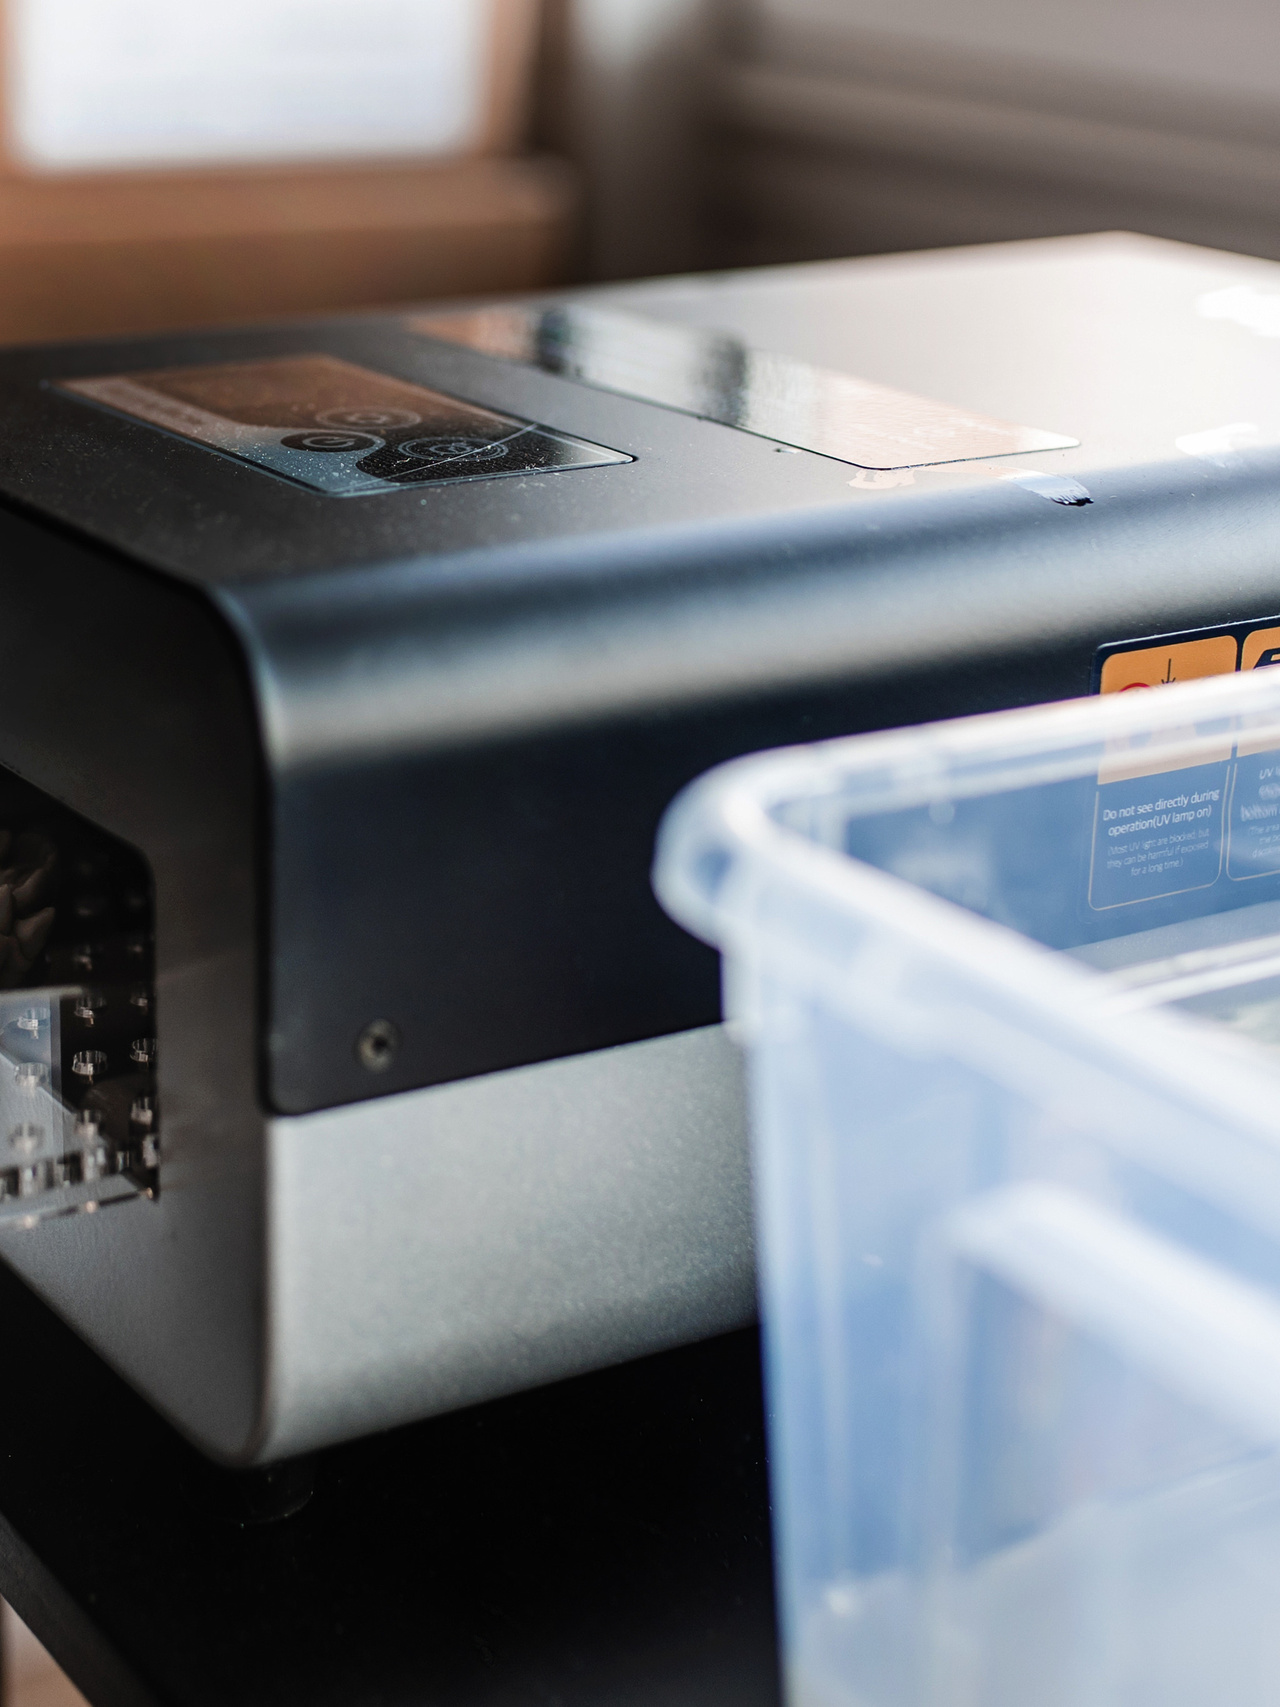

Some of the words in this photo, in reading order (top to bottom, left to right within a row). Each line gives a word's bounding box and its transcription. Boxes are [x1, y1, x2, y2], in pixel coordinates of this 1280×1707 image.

[1260, 767, 1274, 780] UV
[1103, 809, 1117, 821] Do
[1119, 805, 1135, 818] not
[1137, 803, 1153, 814] see
[1155, 794, 1189, 811] directly
[1191, 789, 1220, 804] during
[1108, 813, 1171, 837] operation(UV
[1172, 810, 1195, 822] lamp
[1196, 804, 1212, 818] on)
[1129, 841, 1140, 851] UV
[1157, 837, 1168, 846] are
[1124, 856, 1136, 865] can
[1137, 854, 1147, 862] be
[1131, 867, 1140, 876] for
[1148, 863, 1163, 873] long
